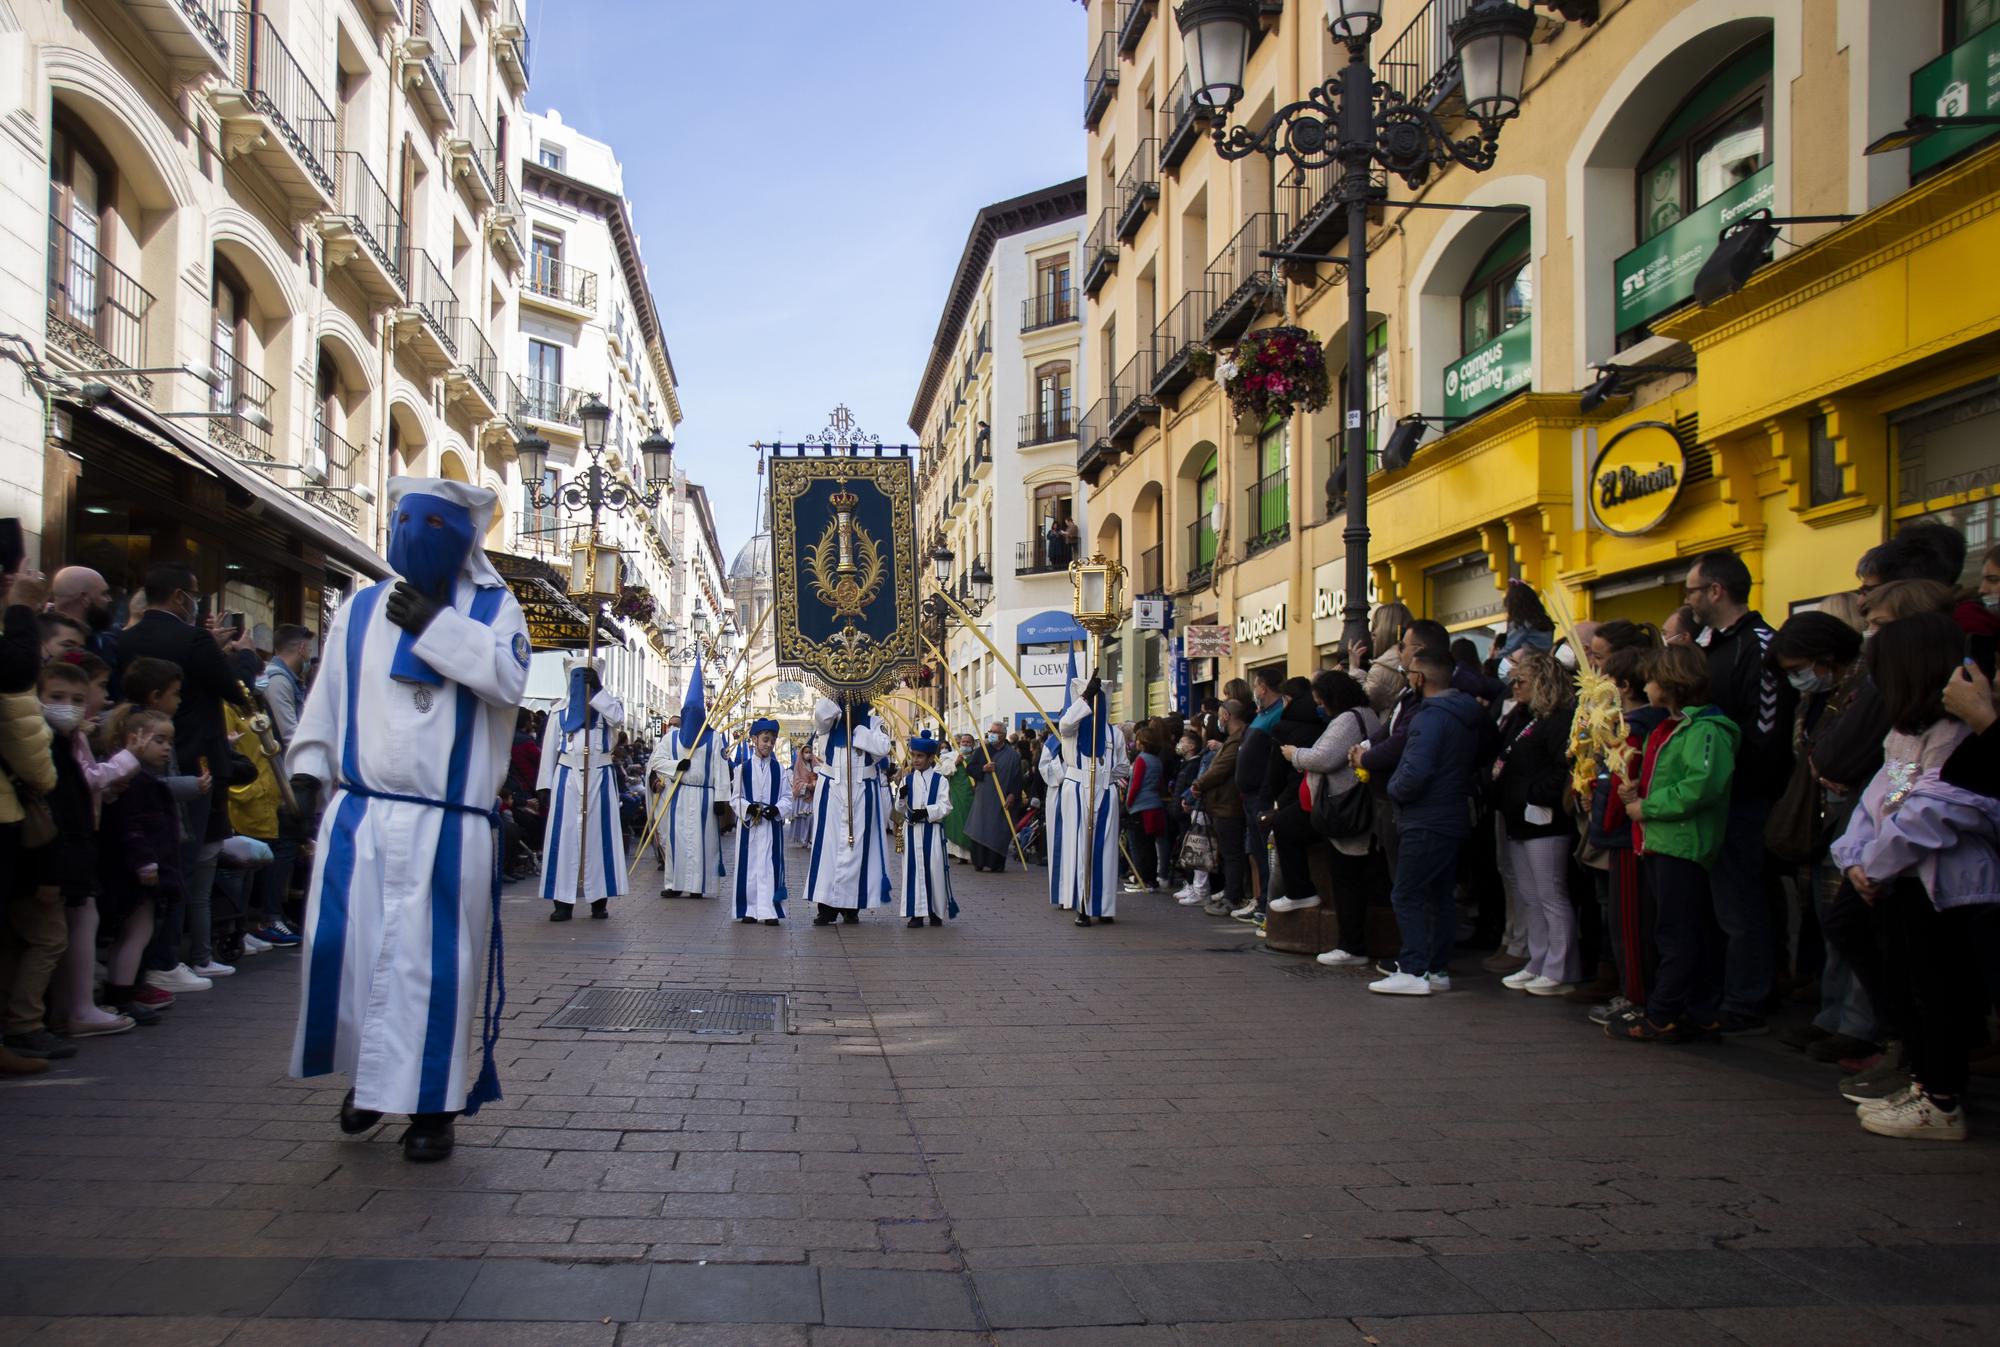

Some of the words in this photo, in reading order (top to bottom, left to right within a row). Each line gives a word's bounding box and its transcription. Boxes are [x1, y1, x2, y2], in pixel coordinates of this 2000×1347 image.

[1460, 341, 1503, 381] campus
[1460, 365, 1504, 402] training
[1033, 663, 1069, 676] LOEW
